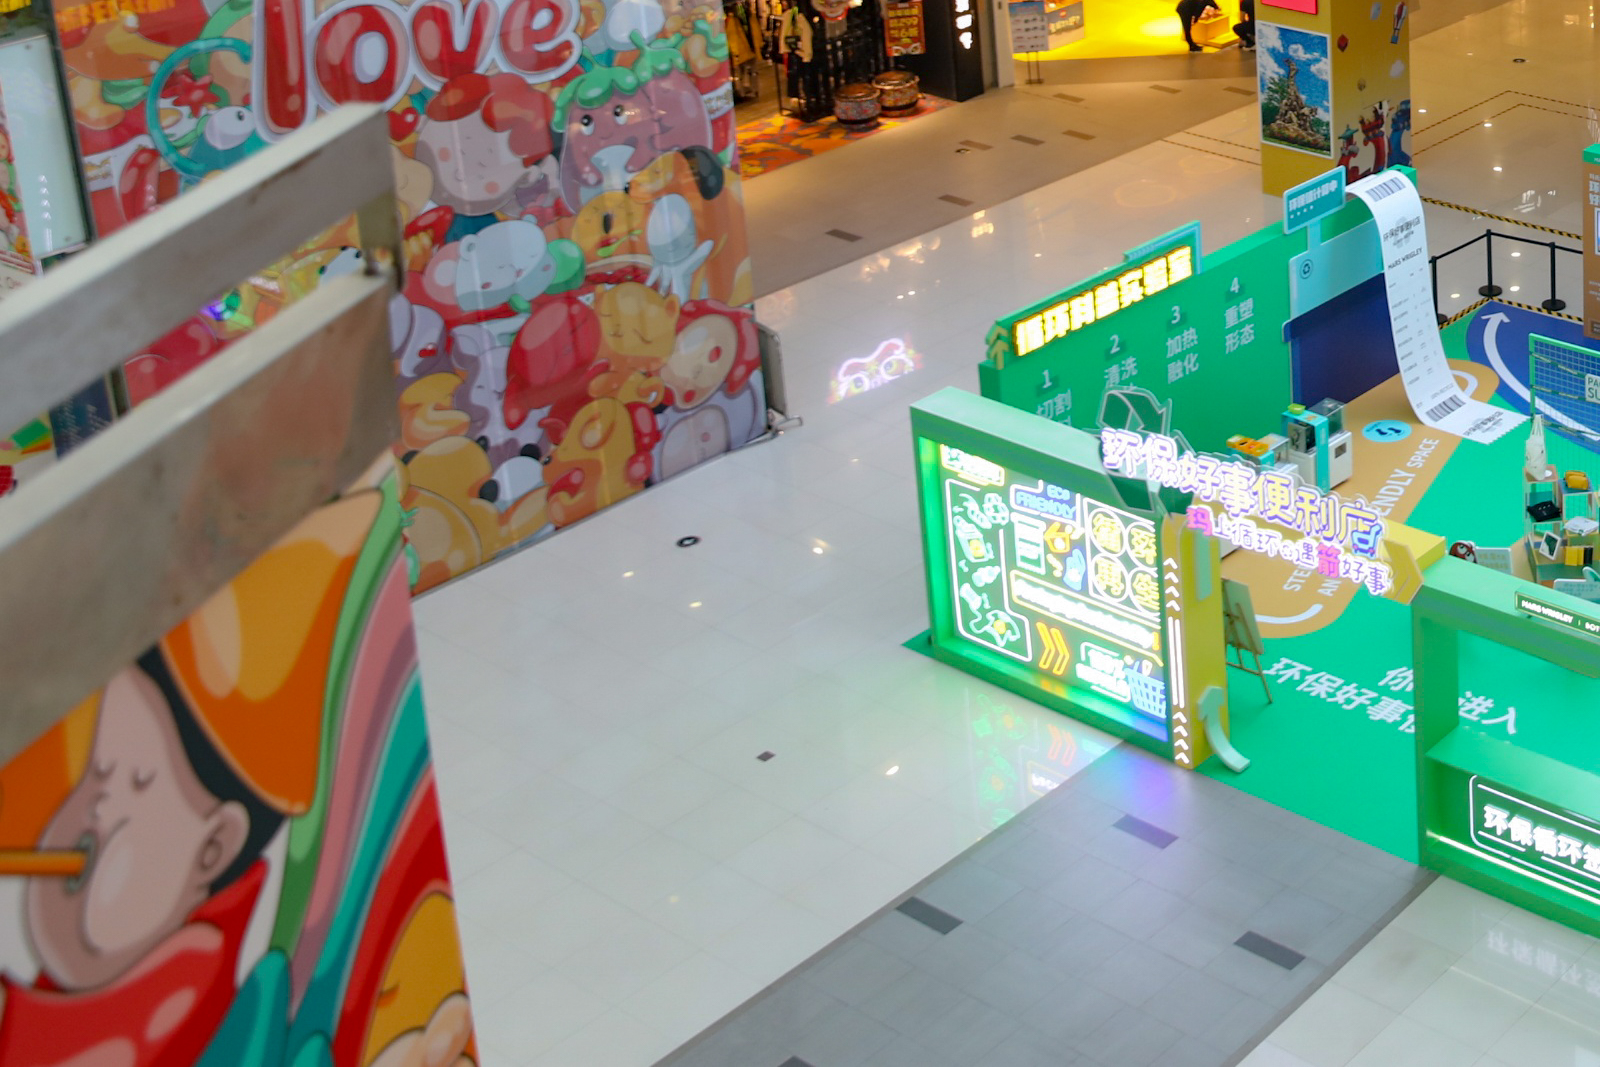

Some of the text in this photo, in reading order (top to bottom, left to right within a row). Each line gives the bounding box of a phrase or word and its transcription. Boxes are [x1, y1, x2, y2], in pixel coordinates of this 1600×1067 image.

[1230, 276, 1241, 294] 4
[1171, 305, 1181, 325] 3
[1224, 297, 1255, 330] 重塑
[1109, 334, 1121, 355] 2
[1166, 327, 1199, 359] 加热
[1225, 323, 1256, 355] 形态
[1042, 369, 1052, 389] 1
[1104, 356, 1138, 388] 清洗
[1166, 353, 1200, 385] 融化
[1409, 438, 1440, 469] SPACE
[1015, 490, 1077, 519] FRIENDLY
[1046, 484, 1071, 501] ECO
[1101, 427, 1383, 556] 环保好事便利店
[1283, 562, 1312, 592] STE
